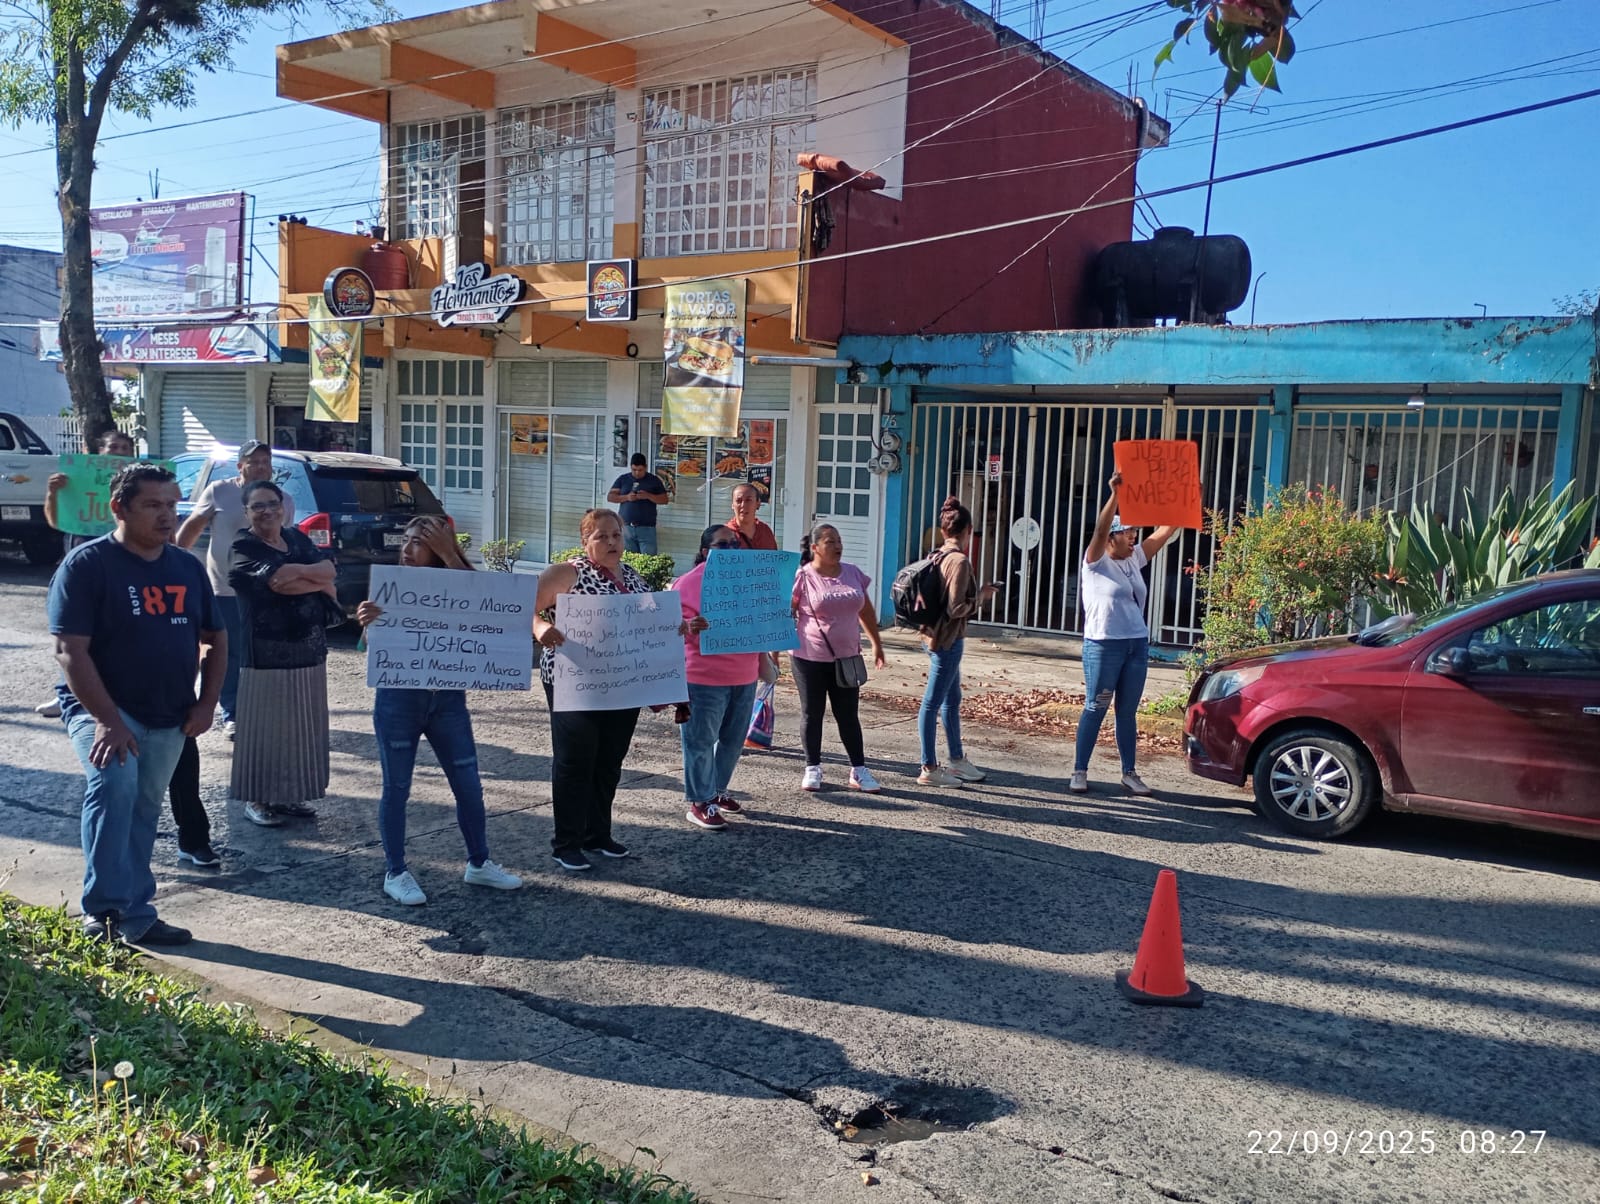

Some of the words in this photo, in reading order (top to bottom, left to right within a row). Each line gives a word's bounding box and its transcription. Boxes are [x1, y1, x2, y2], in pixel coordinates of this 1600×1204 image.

[457, 267, 481, 291] Los
[433, 278, 516, 311] Hermanitos
[678, 290, 730, 304] TORTAS
[669, 304, 684, 316] AL
[688, 303, 736, 317] VAPOR
[110, 343, 117, 360] Y
[122, 334, 133, 359] 6
[150, 333, 180, 345] MESES
[134, 348, 150, 360] SIN
[150, 347, 198, 360] INTERESES
[1130, 441, 1197, 462] JUSTICI
[753, 553, 790, 565] MAESTRO
[142, 585, 187, 616] 87
[375, 581, 470, 610] Maestro
[479, 597, 522, 614] Marco
[565, 597, 620, 624] Exigimos
[402, 616, 449, 631] escuela
[708, 619, 732, 631] IDAS
[375, 650, 405, 670] Para
[410, 658, 424, 669] el
[428, 659, 477, 673] Maestro
[484, 660, 521, 677] Marco
[376, 671, 421, 687] Antonio
[426, 676, 467, 688] Moreno
